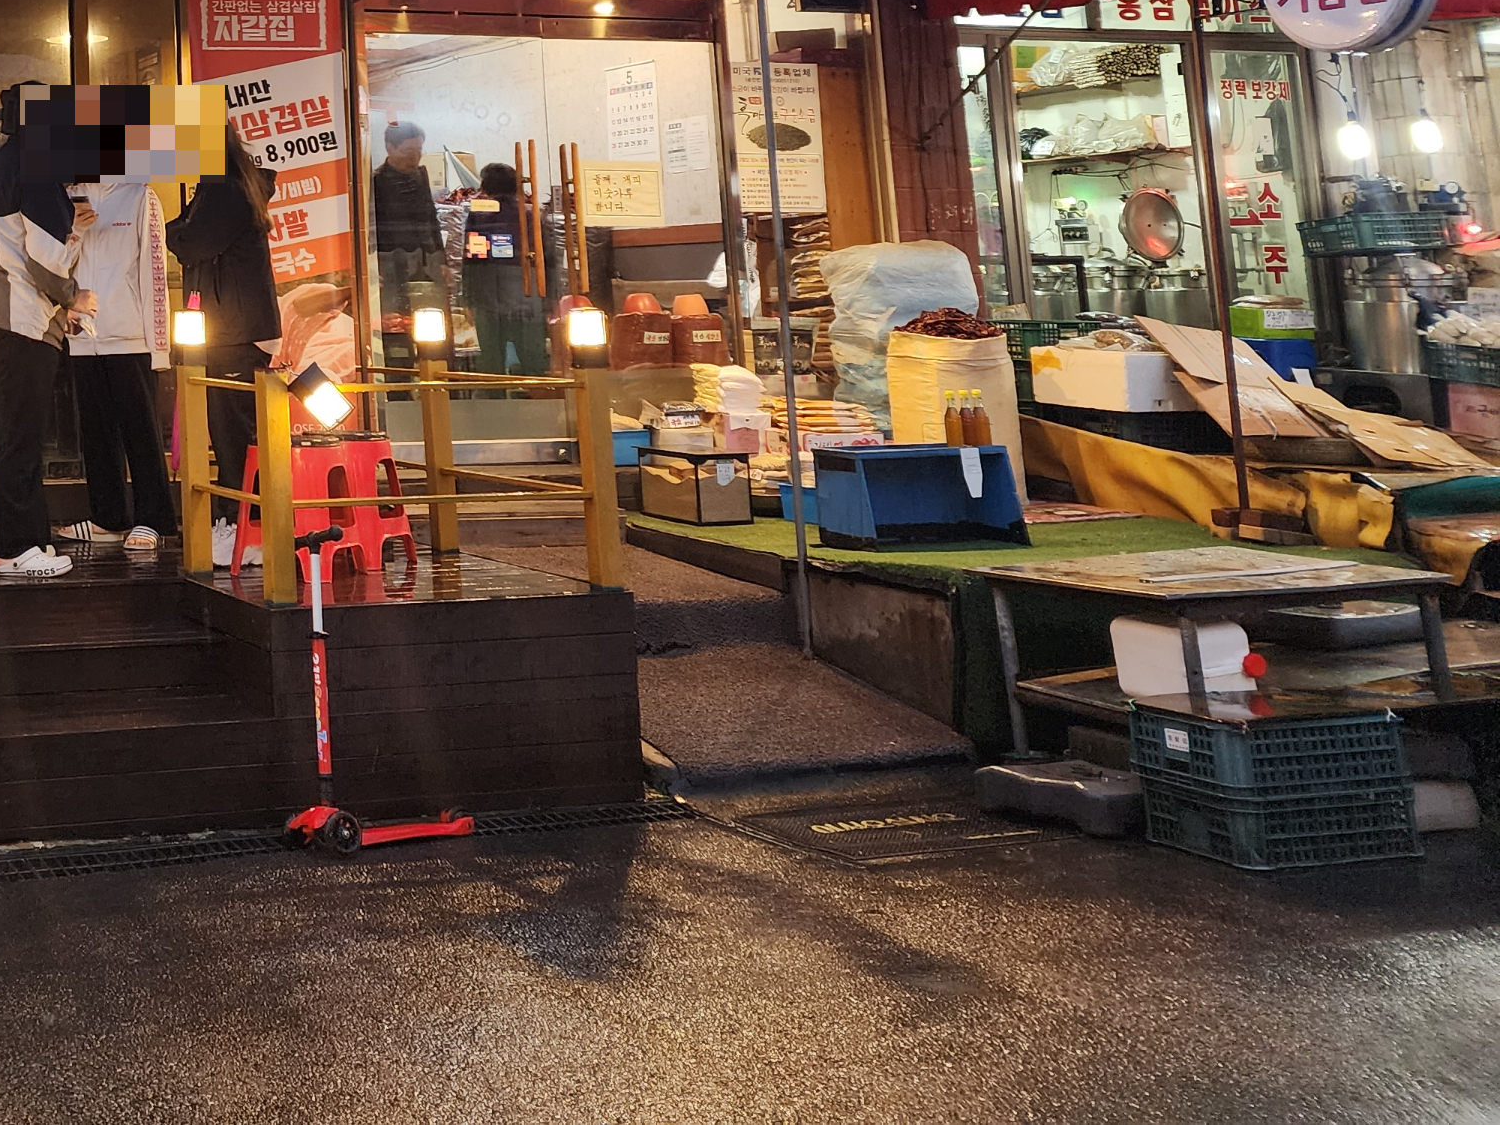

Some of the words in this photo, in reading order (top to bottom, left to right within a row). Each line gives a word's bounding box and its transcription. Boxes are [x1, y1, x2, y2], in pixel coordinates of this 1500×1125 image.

[212, 0, 262, 14] 간판없는
[266, 0, 316, 15] 삼겹살집
[213, 15, 295, 43] 자갈집
[228, 79, 272, 109] 내산
[1220, 79, 1248, 101] 정력
[1252, 79, 1291, 101] 보강제
[266, 131, 338, 164] 8,900원
[268, 209, 309, 242] 사발
